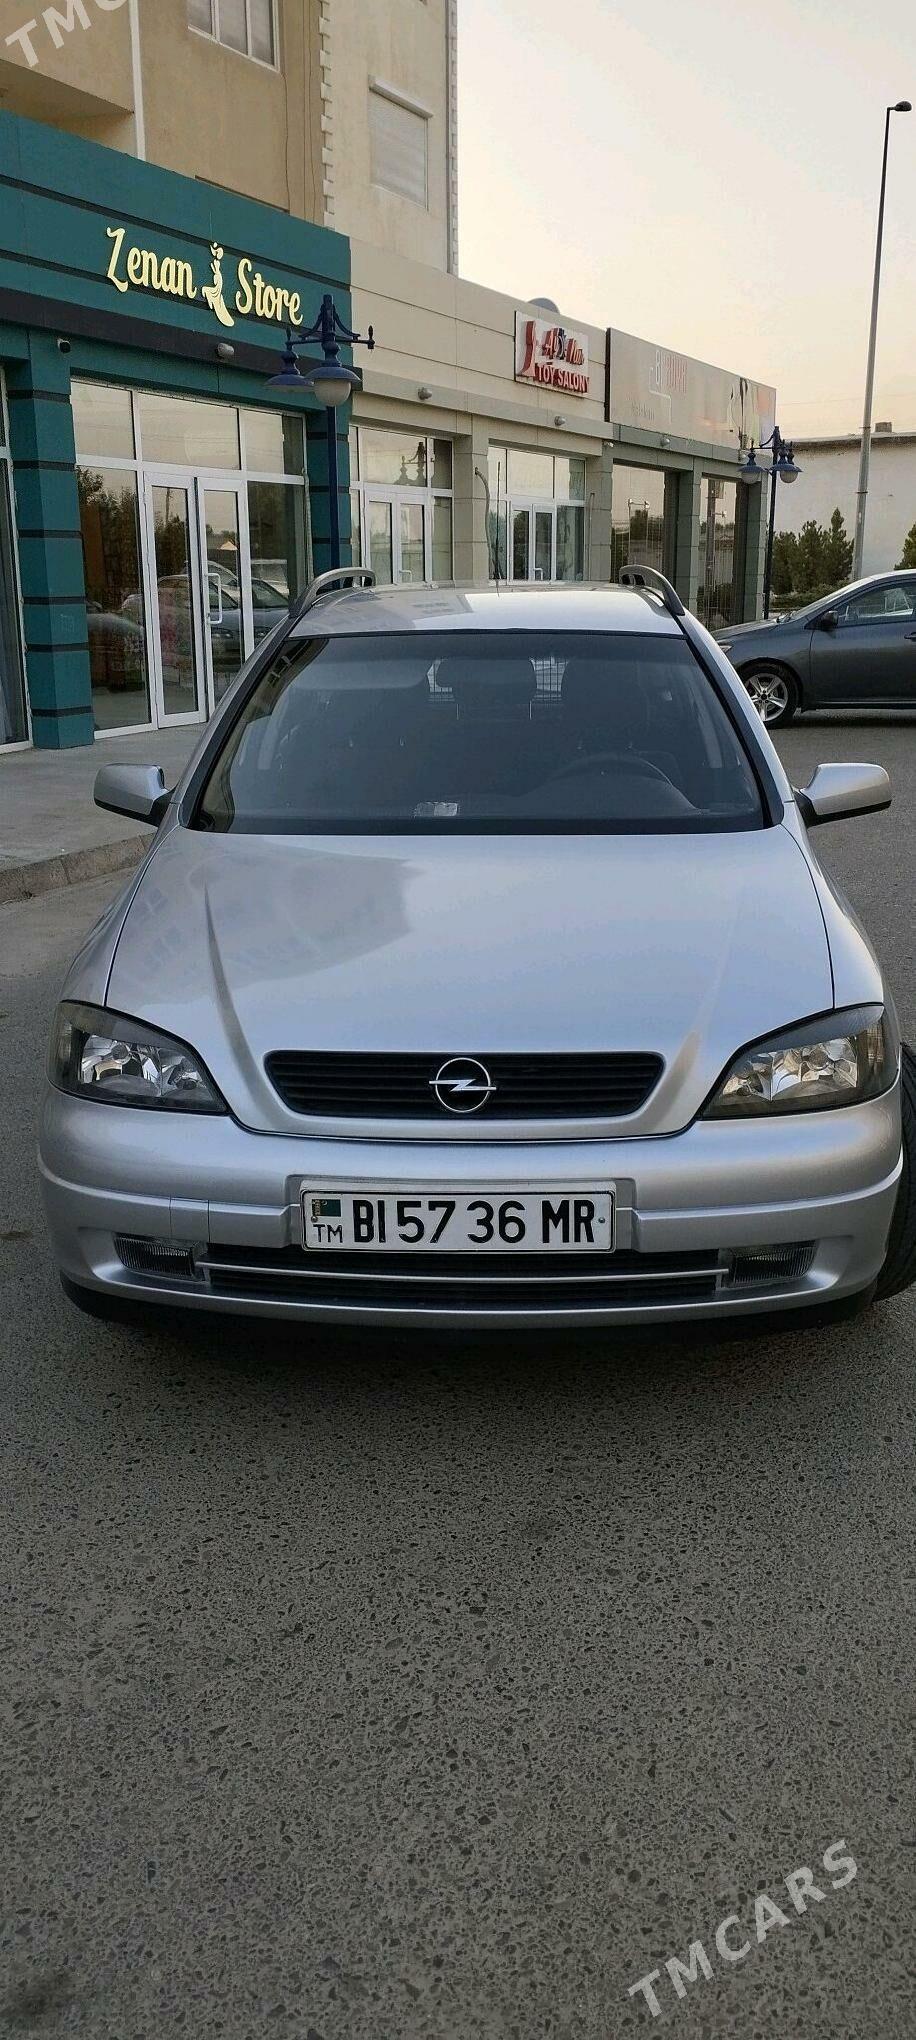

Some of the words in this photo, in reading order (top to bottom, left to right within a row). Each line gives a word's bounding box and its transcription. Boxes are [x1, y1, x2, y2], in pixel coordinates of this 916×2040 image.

[106, 227, 197, 299] Zenan
[235, 258, 303, 326] Store
[312, 1223, 344, 1244] TM
[396, 1199, 456, 1244] 57
[466, 1199, 526, 1244] 36
[541, 1199, 595, 1243] MR
